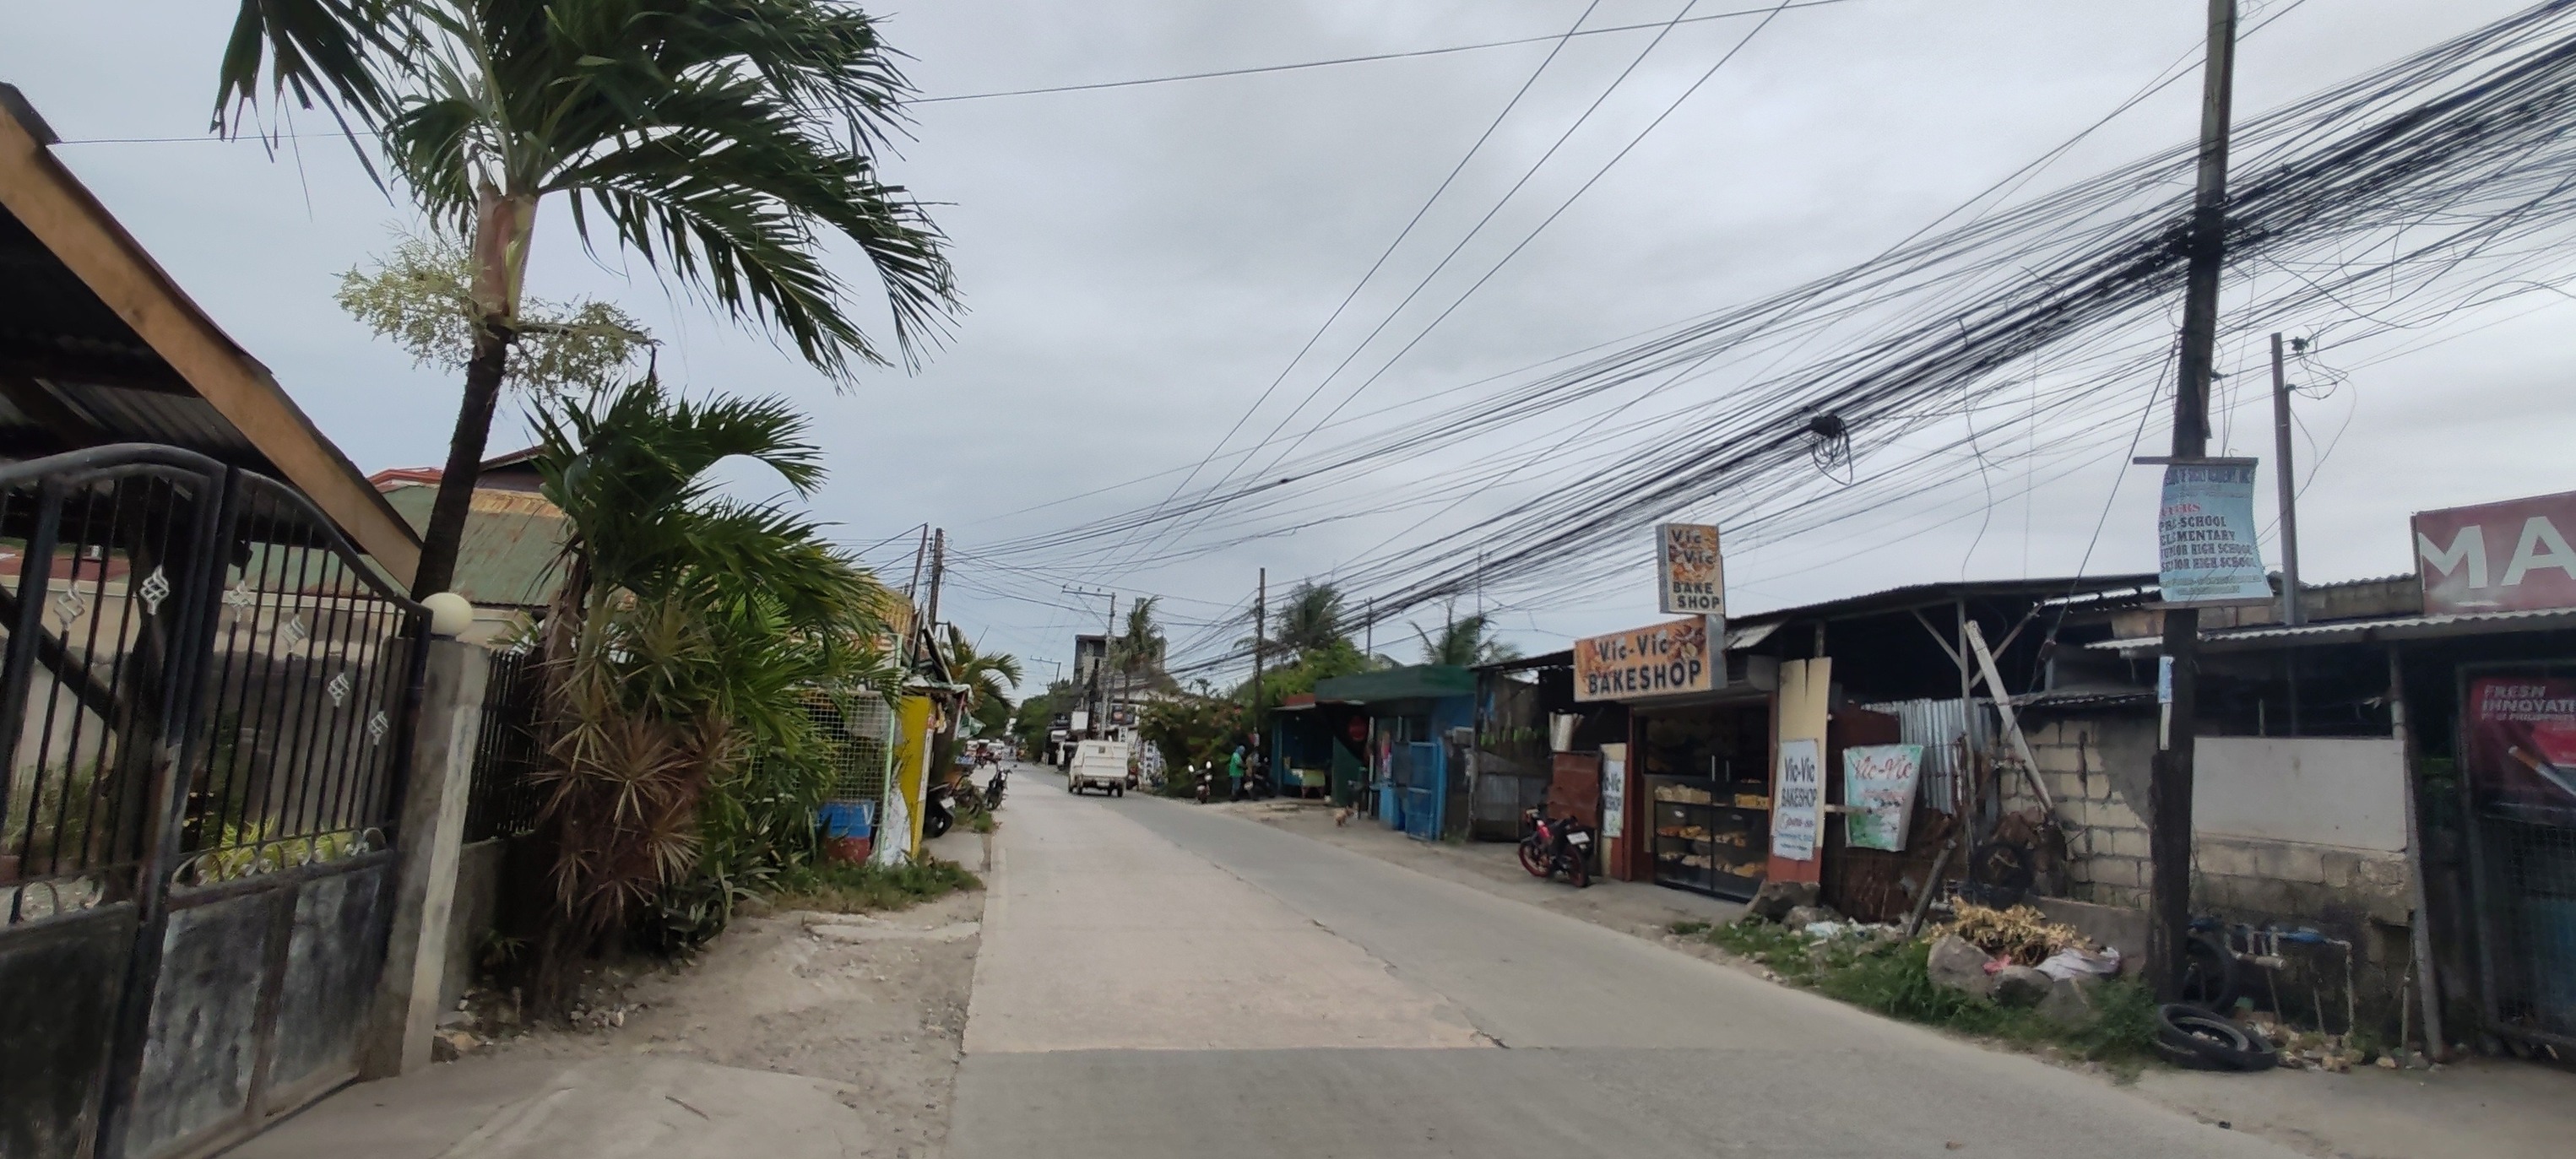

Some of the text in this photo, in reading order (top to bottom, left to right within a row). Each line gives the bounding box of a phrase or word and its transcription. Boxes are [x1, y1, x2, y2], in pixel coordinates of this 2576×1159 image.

[2161, 530, 2235, 546] ELEMENTARY
[2191, 544, 2215, 555] HIGH
[2218, 544, 2253, 555] SCHOOL
[2418, 516, 2576, 590] MA
[2194, 558, 2217, 569] HIGH
[2220, 557, 2257, 568] SCHOOL
[1673, 582, 1713, 593] BAKE
[1678, 595, 1720, 608] SHOP
[1599, 634, 1668, 662] Vic-Vic
[1588, 659, 1701, 695] BAKESHOP
[1784, 756, 1814, 783] Vic-Vic
[1781, 788, 1816, 808] BAKESHOP
